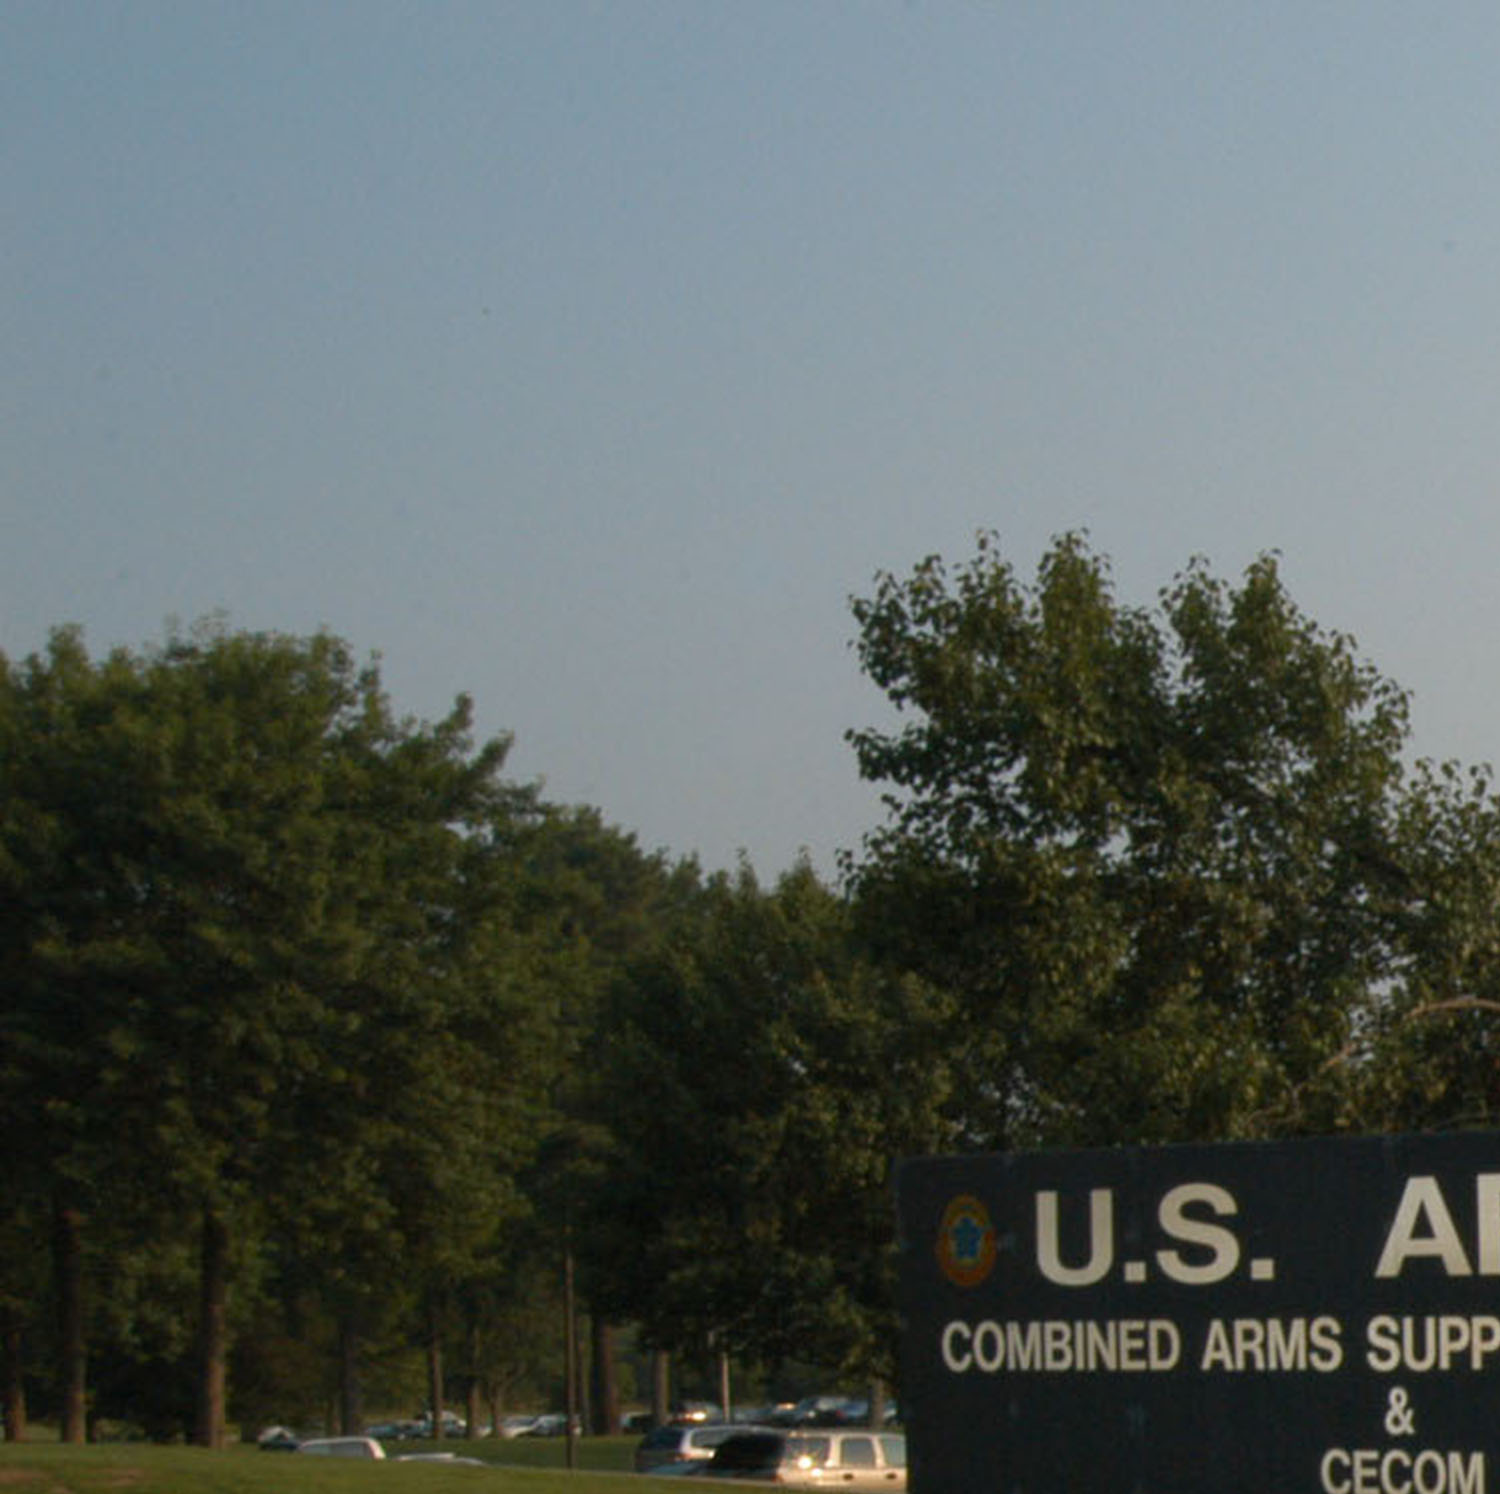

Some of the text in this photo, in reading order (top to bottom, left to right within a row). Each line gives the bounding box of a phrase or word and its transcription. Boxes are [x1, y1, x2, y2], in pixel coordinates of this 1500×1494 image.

[1034, 1183, 1275, 1286] U.S.
[942, 1320, 1180, 1372] COMBINED
[1201, 1316, 1343, 1372] ARMS
[1384, 1386, 1415, 1435] &
